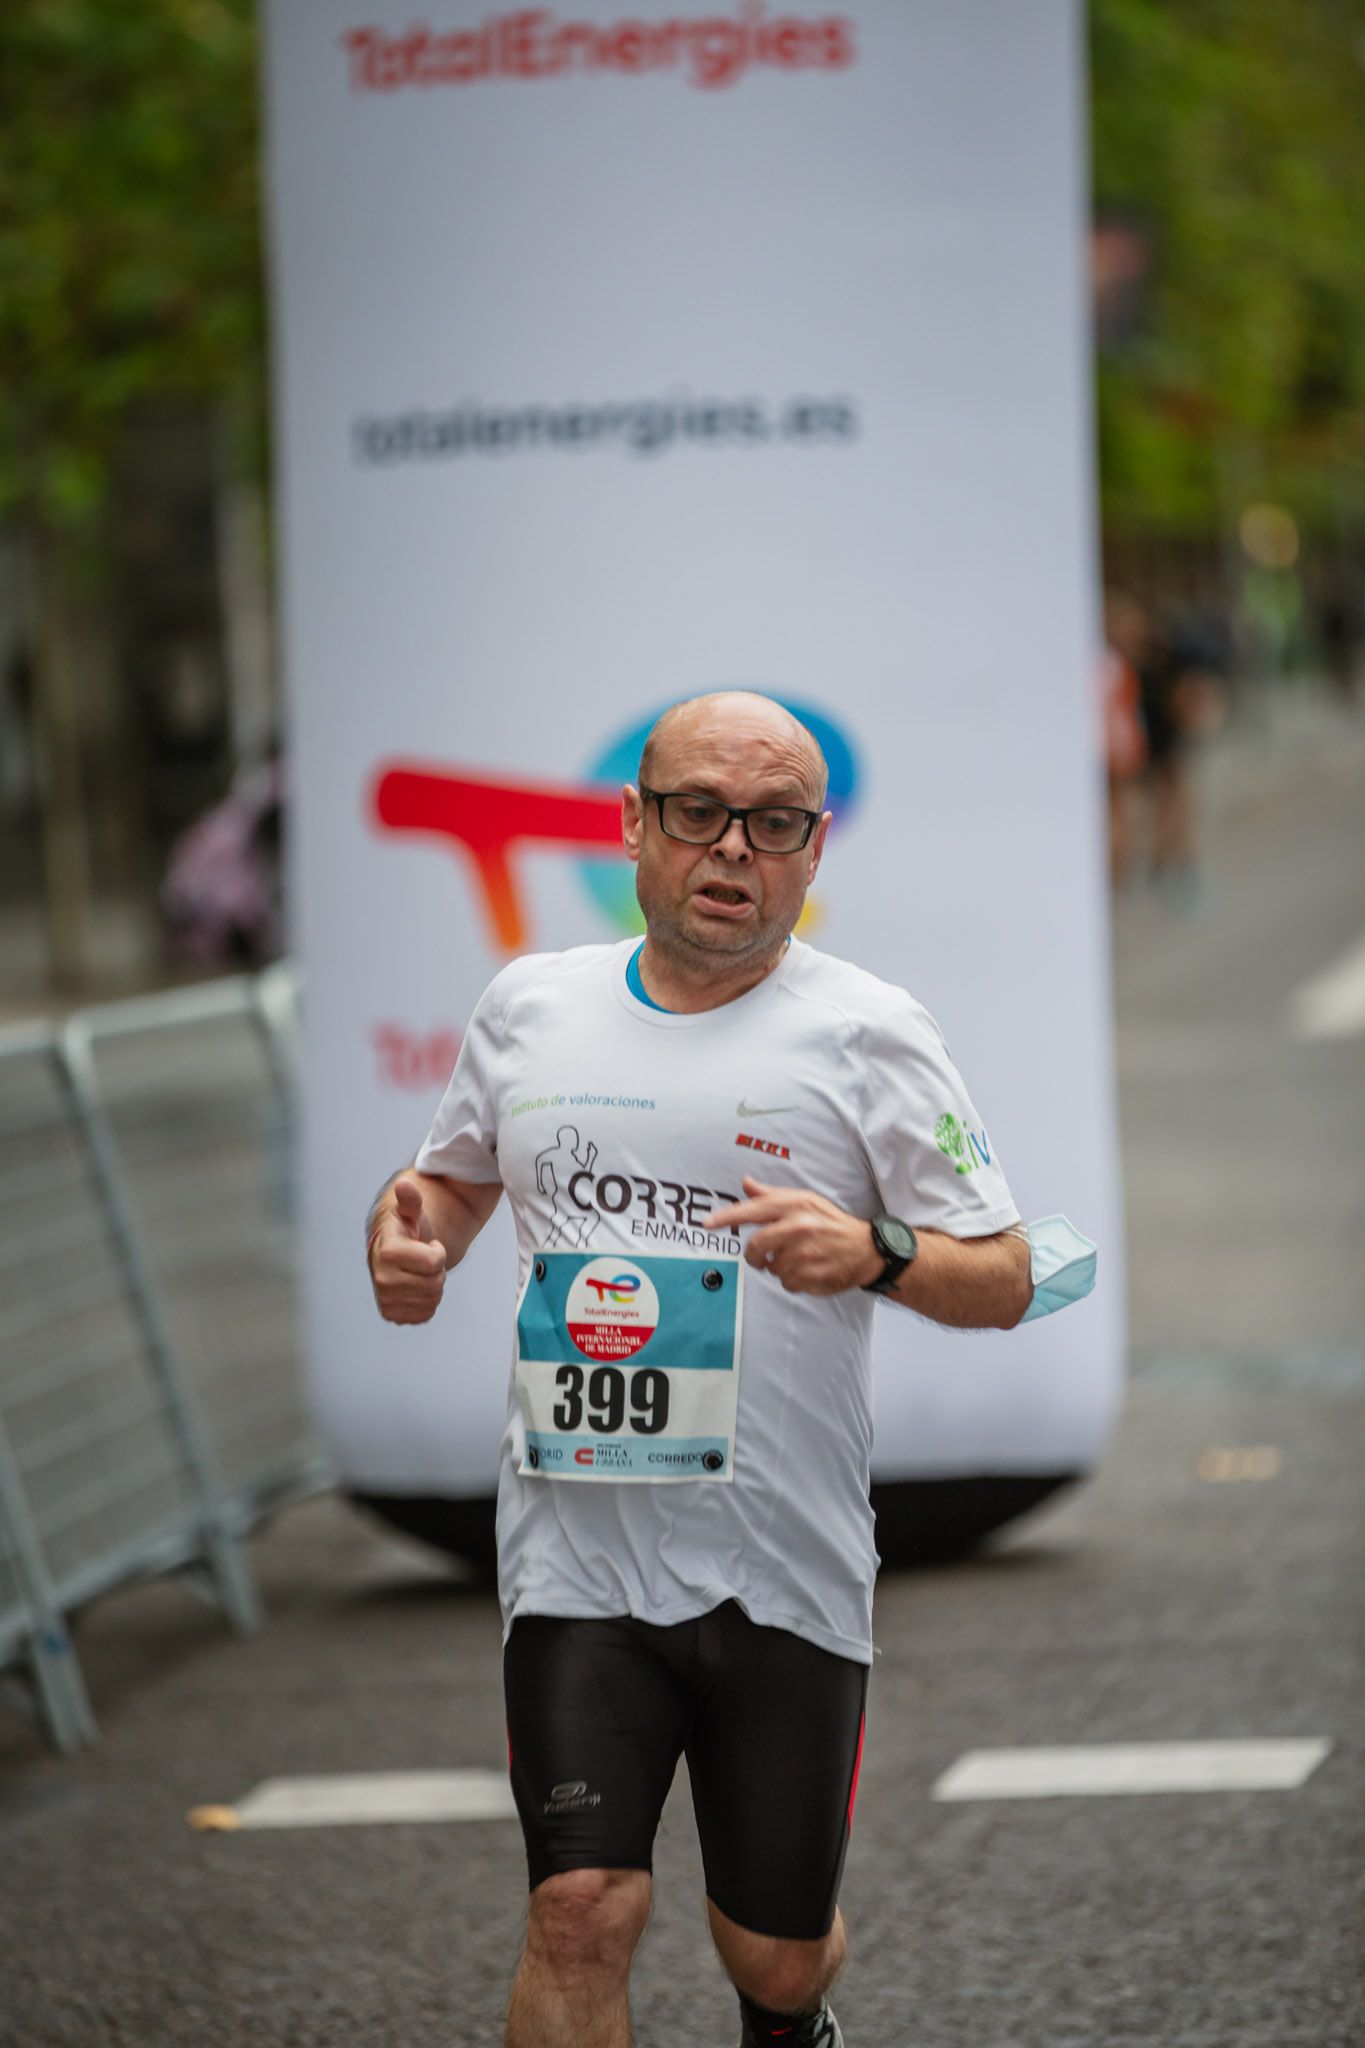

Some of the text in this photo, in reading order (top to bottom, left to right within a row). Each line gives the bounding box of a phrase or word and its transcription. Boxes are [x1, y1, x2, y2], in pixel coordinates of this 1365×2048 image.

[345, 5, 856, 92] TotalEnergies
[551, 1093, 566, 1106] de
[569, 1093, 656, 1110] valoraciones
[631, 1219, 741, 1256] ENMADRID
[584, 1307, 640, 1318] TotalEnergies
[595, 1326, 622, 1336] MILLA
[585, 1344, 632, 1355] DE MADRID
[553, 1365, 670, 1435] 399
[648, 1453, 706, 1466] CORREDO
